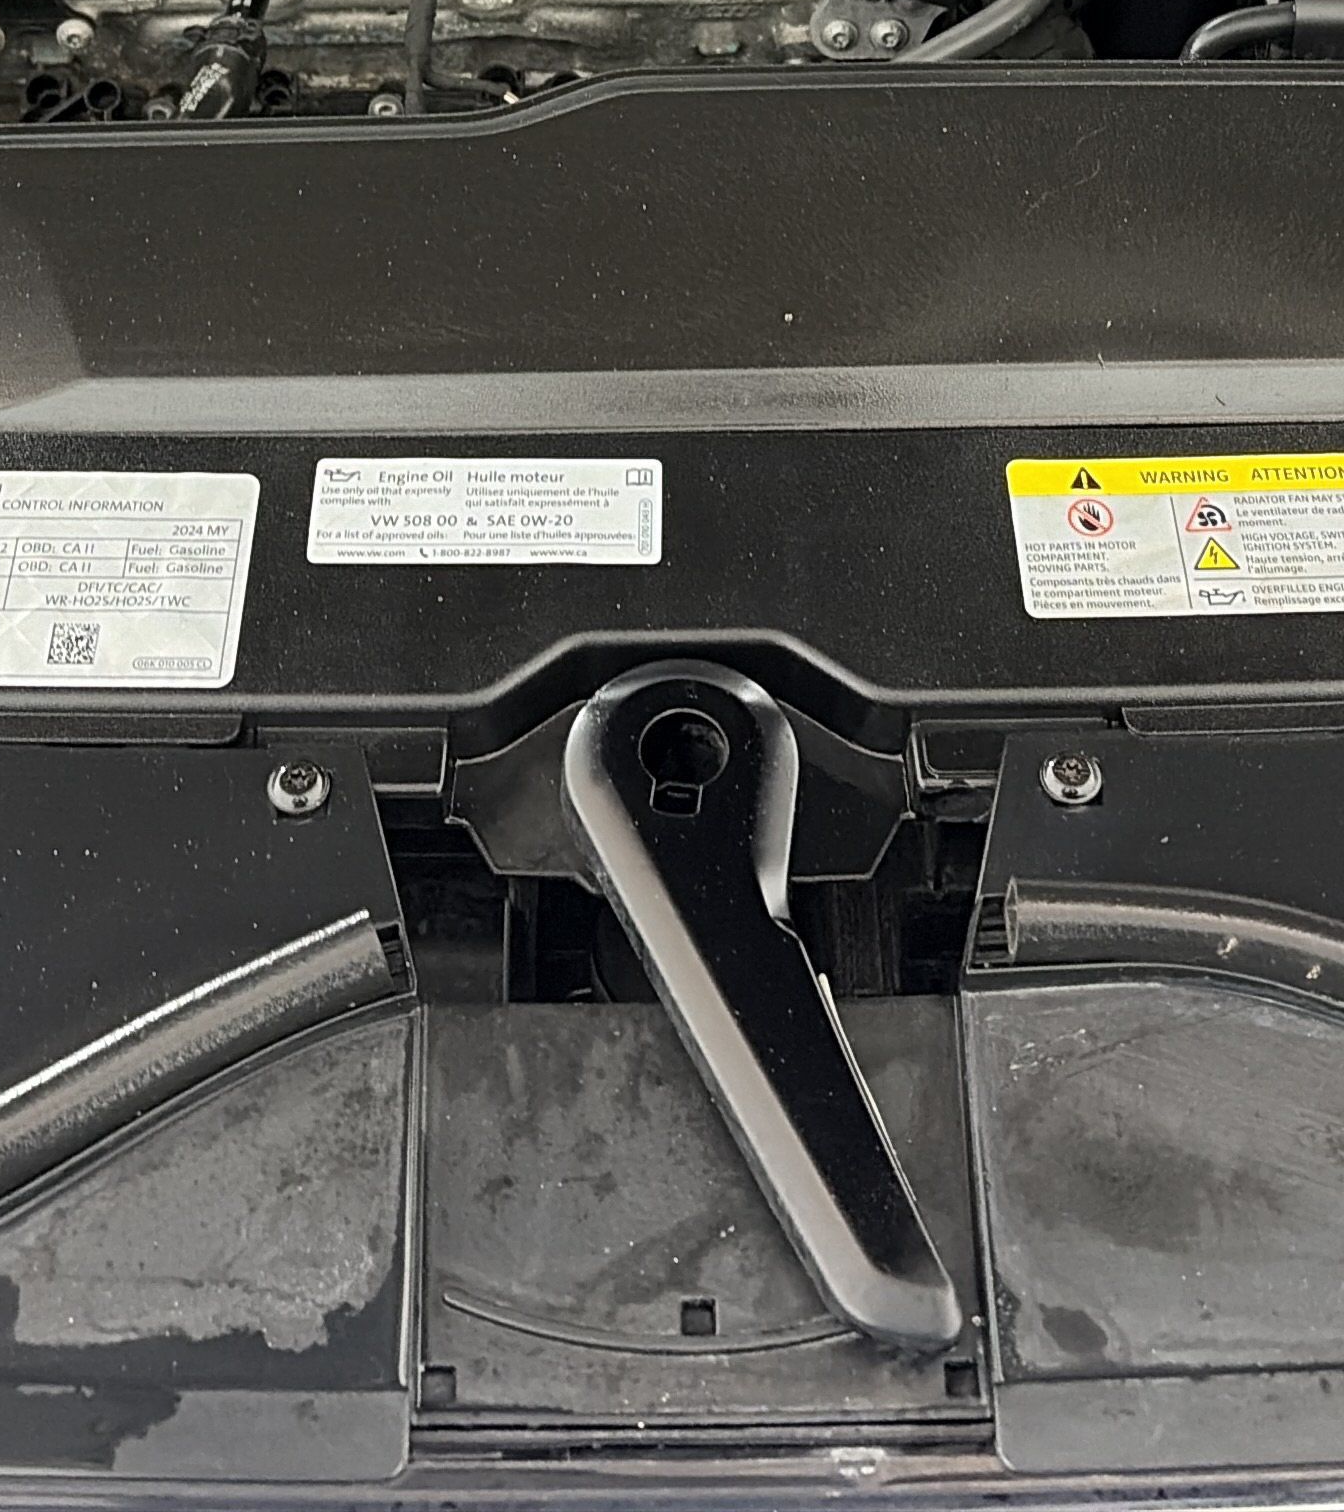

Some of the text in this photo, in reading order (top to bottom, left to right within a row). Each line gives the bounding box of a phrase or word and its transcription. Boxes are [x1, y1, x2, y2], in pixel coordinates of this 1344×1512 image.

[379, 471, 453, 486] Engine Oil
[467, 471, 565, 483] Huile moteur
[1140, 469, 1229, 484] WARNING
[321, 486, 451, 497] Use only oil that expressly
[466, 487, 619, 499] Utilisez uniquement de l'huile
[320, 496, 391, 507] complies with
[465, 498, 482, 509] qui
[484, 498, 525, 507] satisfait
[528, 498, 600, 509] expressément
[1234, 495, 1286, 505] RADIATOR
[1288, 494, 1309, 503] FAN
[1311, 494, 1333, 503] MAY
[3, 500, 65, 511] CONTROL
[68, 500, 164, 512] INFORMATION
[1236, 509, 1249, 517] Le
[1251, 506, 1309, 517] ventilateur
[1311, 506, 1325, 515] de
[371, 514, 574, 527] VW 508 00 & SAE 0W-20
[1238, 518, 1286, 527] moment.
[172, 525, 229, 536] 2024 MY
[316, 529, 332, 538] For
[344, 530, 359, 538] list
[362, 530, 374, 538] of
[376, 530, 424, 541] approved
[463, 531, 486, 539] Pour
[510, 531, 530, 539] liste
[533, 530, 572, 540] d'huiles
[1241, 533, 1267, 542] HIGH
[22, 543, 55, 554] OBD:
[62, 543, 82, 554] CA
[131, 545, 226, 556] Fuel: Gasoline
[1025, 541, 1136, 552] HOT PARTS IN MOTOR
[1243, 541, 1336, 552] IGNITION SYSTEM.
[337, 549, 406, 557] www.vw.com
[530, 549, 588, 557] www.vw.ca
[1026, 552, 1109, 562] COMPARTMENT.
[1246, 555, 1278, 564] Haute
[1281, 554, 1324, 565] tension,
[18, 562, 52, 572] OBD:
[59, 562, 79, 572] CA
[128, 563, 223, 574] Fuel: Gasoline
[1028, 562, 1110, 573] MOVING PARTS.
[1030, 574, 1181, 588] Composants très chauds dans
[77, 582, 162, 594] DFI/TC/CAC/
[1031, 589, 1041, 598] le
[1044, 588, 1121, 599] compartiment
[1251, 584, 1316, 594] OVERFILLED
[1033, 599, 1155, 610] Pièces en mouvement.
[1254, 595, 1321, 606] Remplissage
